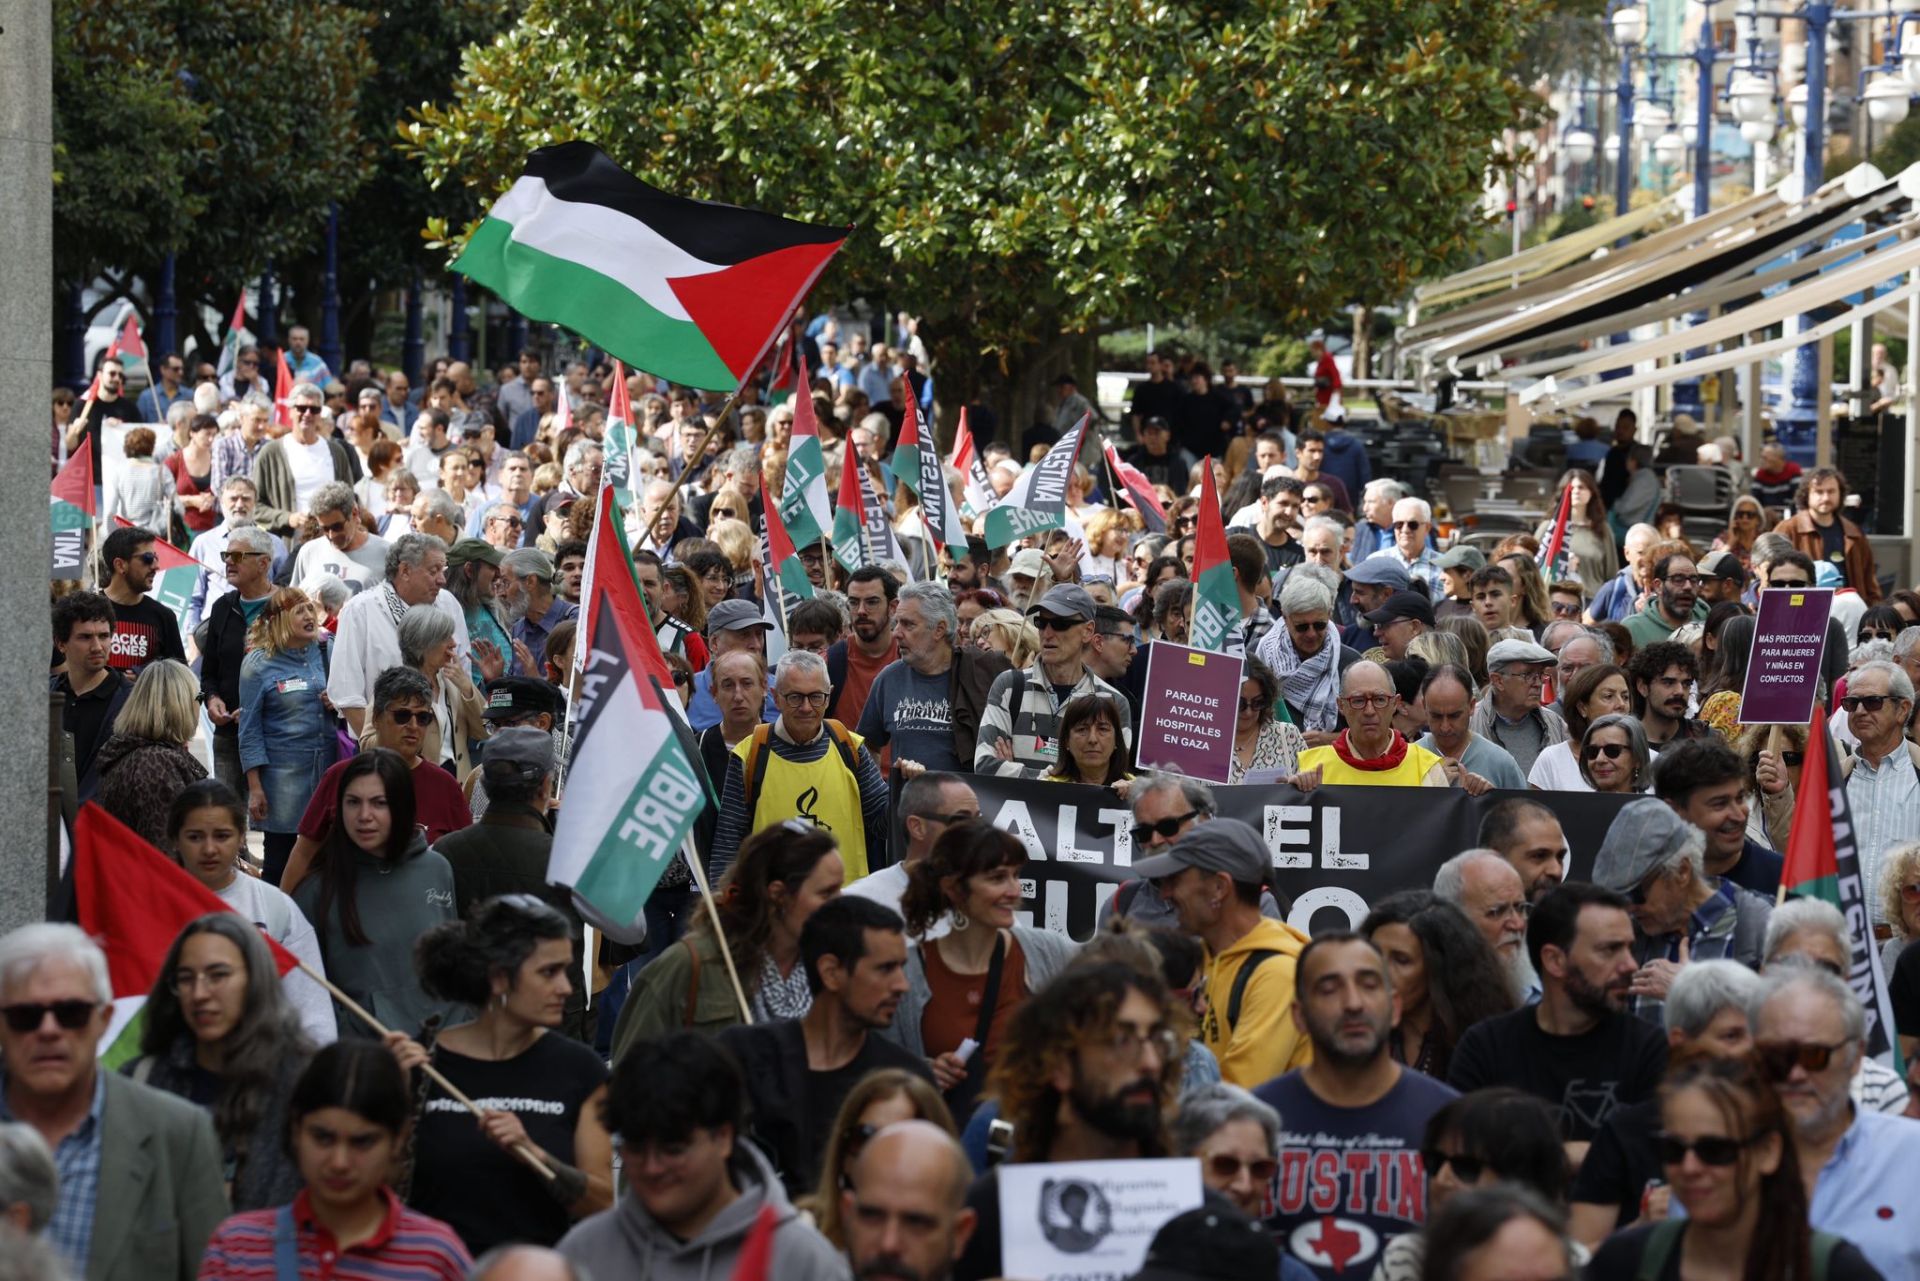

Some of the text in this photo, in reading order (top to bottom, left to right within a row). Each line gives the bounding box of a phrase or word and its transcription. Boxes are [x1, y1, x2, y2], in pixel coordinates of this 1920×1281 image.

[1033, 429, 1080, 502] PALESTINA
[111, 632, 148, 647] ACK&
[1758, 633, 1821, 644] MÁS PROTECCIÓN
[111, 643, 147, 657] ONES
[1761, 649, 1815, 657] PARA MUJERES
[1771, 660, 1793, 669] NIÑAS
[1794, 662, 1804, 670] EN
[1760, 675, 1804, 683] CONFLICTOS
[1165, 689, 1219, 708] PARAD DE
[1170, 705, 1213, 722] ATACAR
[1156, 717, 1221, 738] HOSPITALES
[1163, 733, 1210, 751] EN GAZA
[993, 799, 1370, 870] ALT EL
